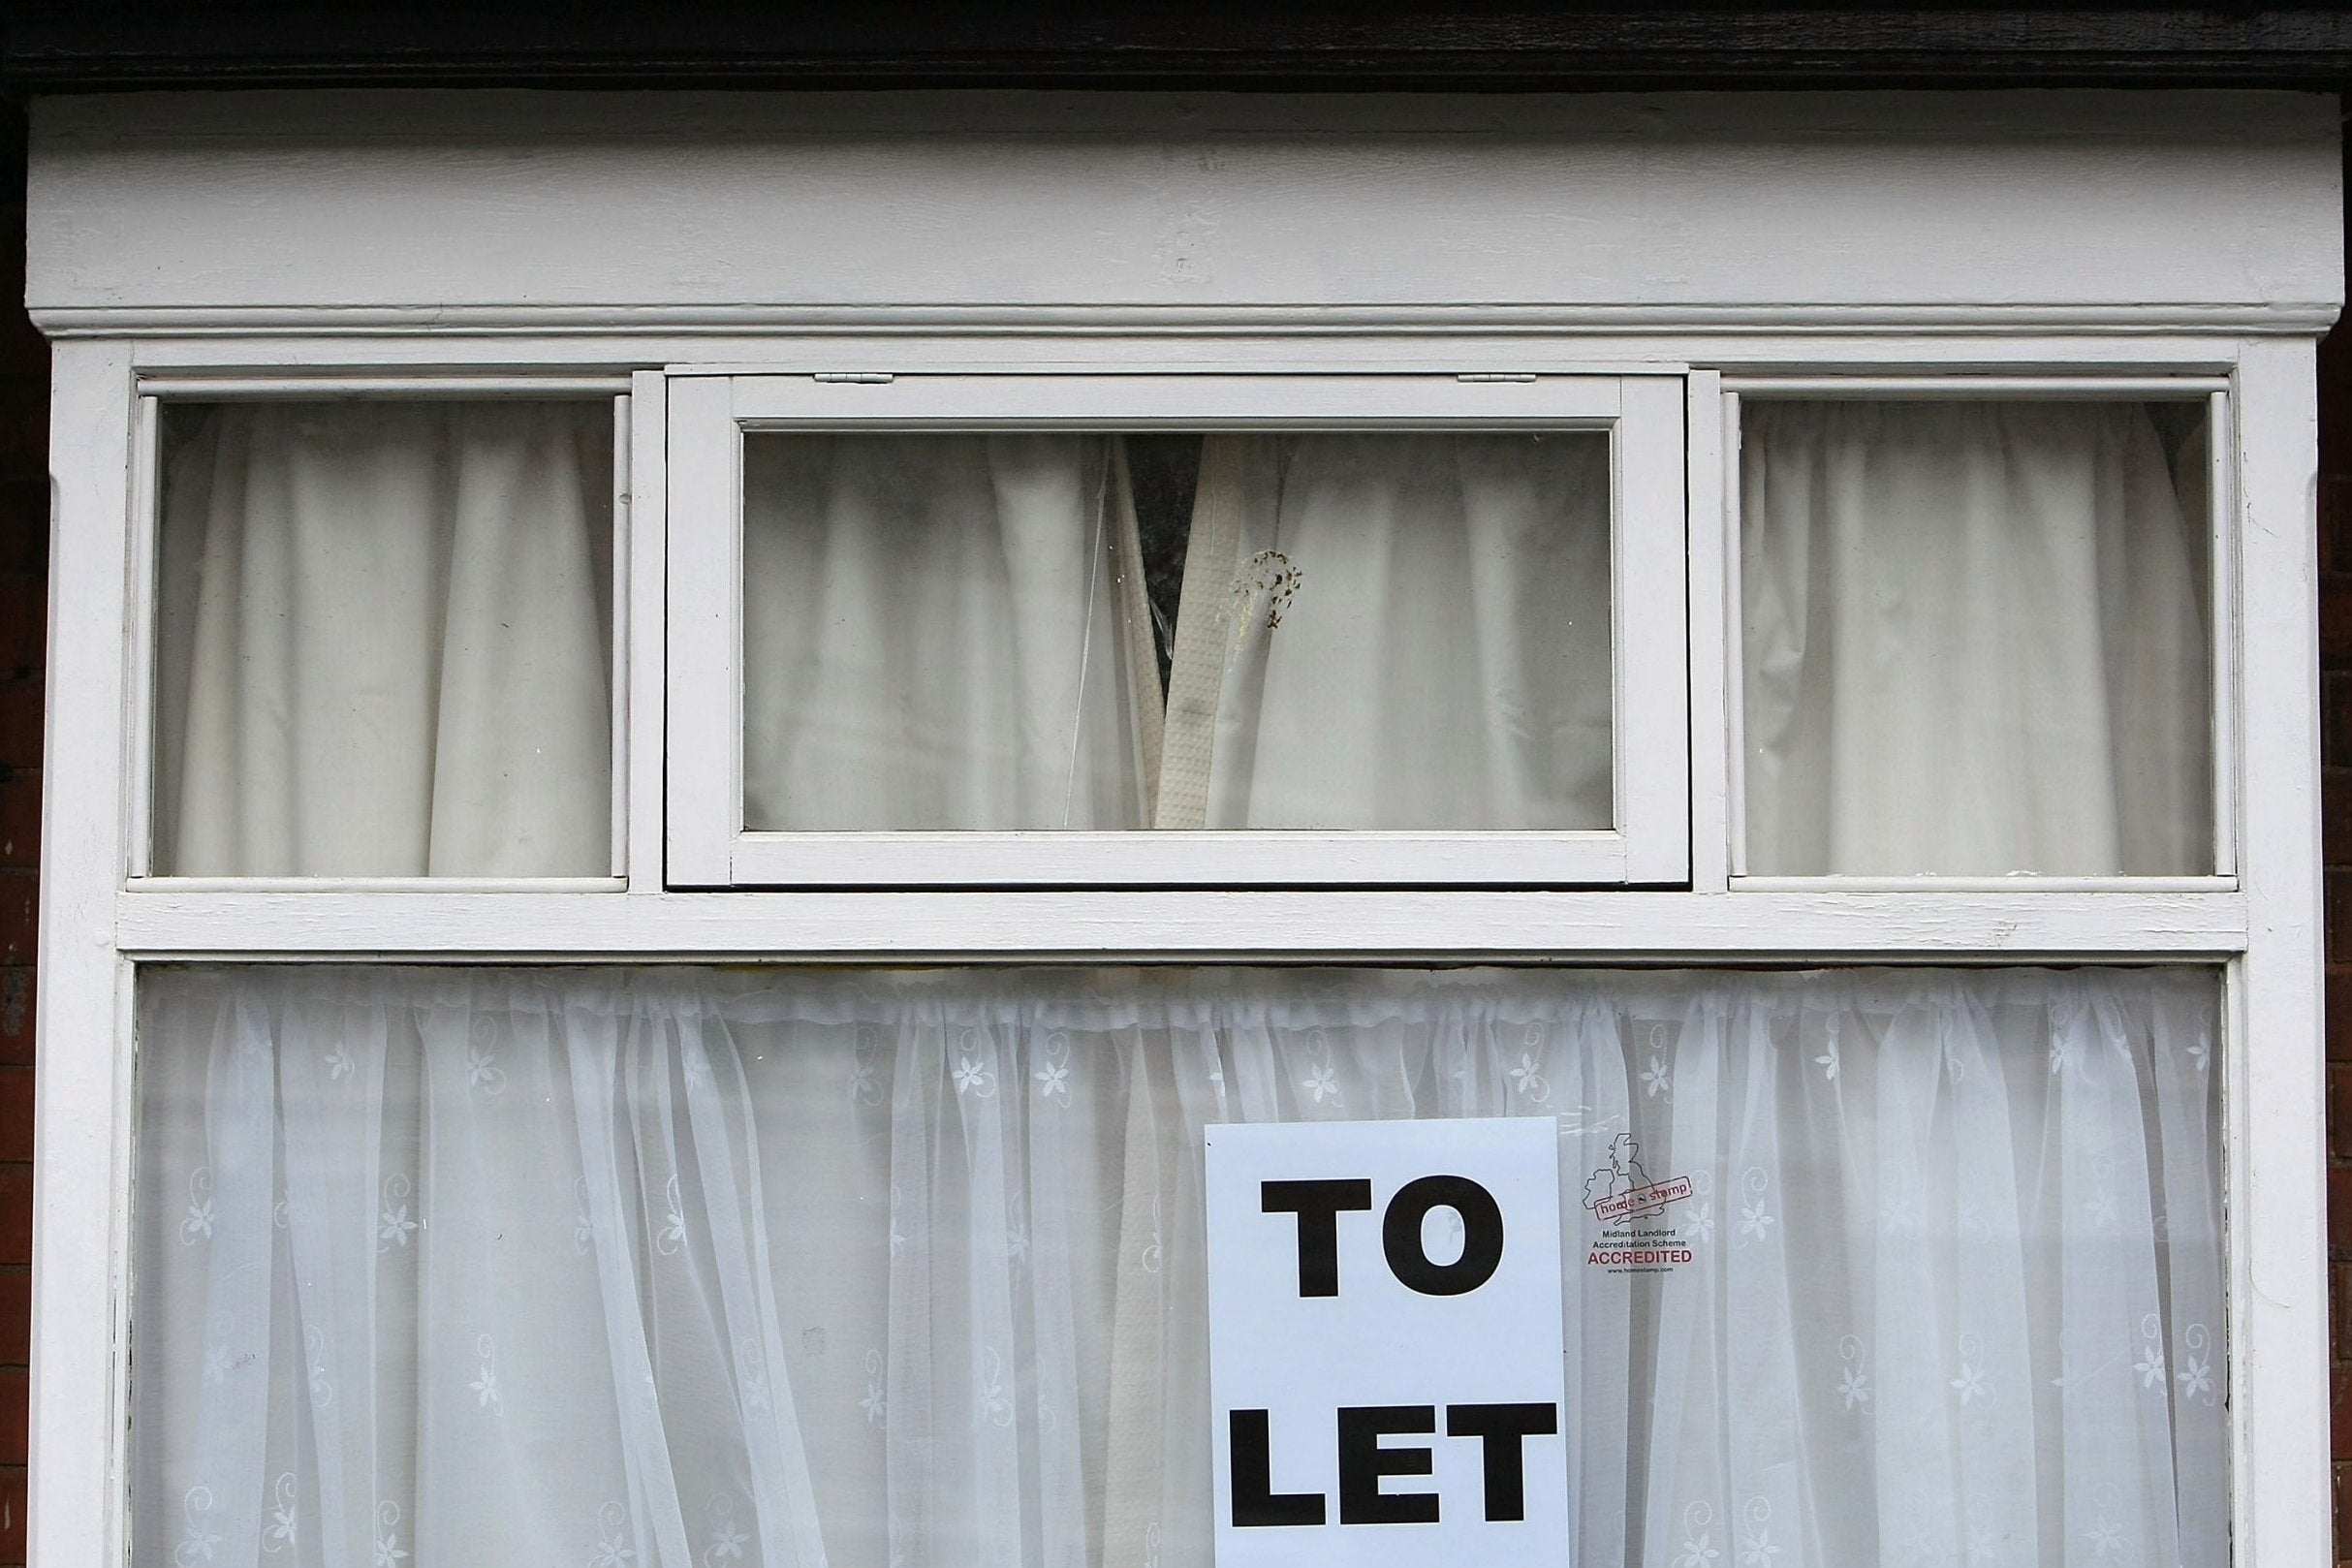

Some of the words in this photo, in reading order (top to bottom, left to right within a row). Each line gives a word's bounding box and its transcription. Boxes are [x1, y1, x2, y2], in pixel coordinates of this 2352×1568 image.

[1600, 1198, 1635, 1214] home
[1649, 1184, 1687, 1201] stamp
[1261, 1175, 1504, 1297] TO
[1592, 1240, 1650, 1249] Accreditation
[1602, 1230, 1636, 1239] Midland
[1638, 1229, 1676, 1238] Landlord
[1587, 1250, 1692, 1265] ACCREDITED
[1229, 1402, 1557, 1527] LET
